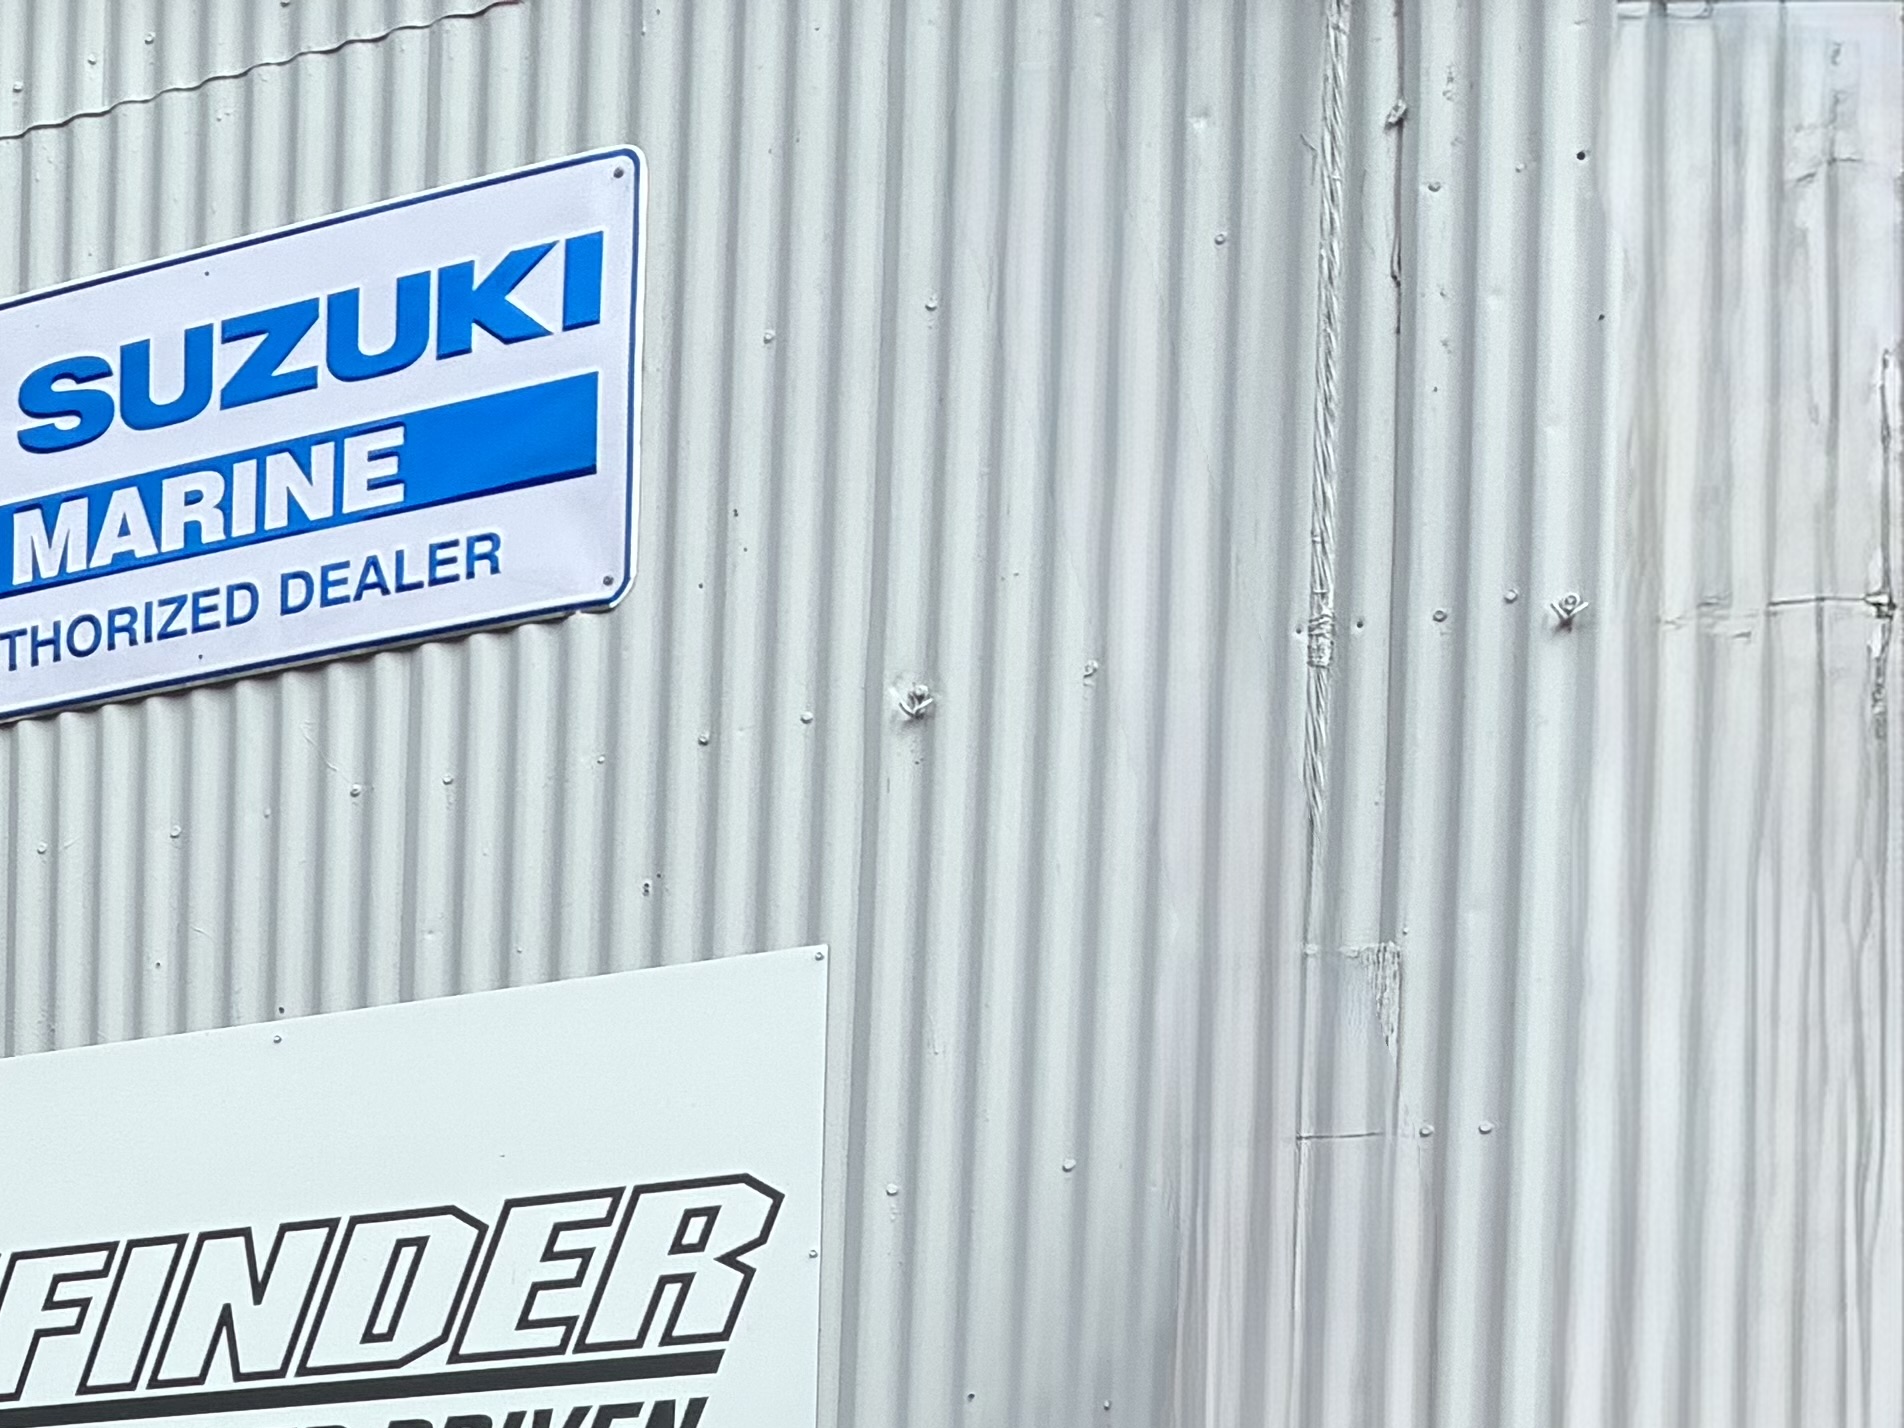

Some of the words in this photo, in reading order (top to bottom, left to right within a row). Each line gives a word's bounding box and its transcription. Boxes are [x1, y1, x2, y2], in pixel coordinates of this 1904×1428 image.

[18, 231, 604, 453] SUZUKI
[11, 425, 405, 586] MARINE
[278, 531, 502, 617] DEALER
